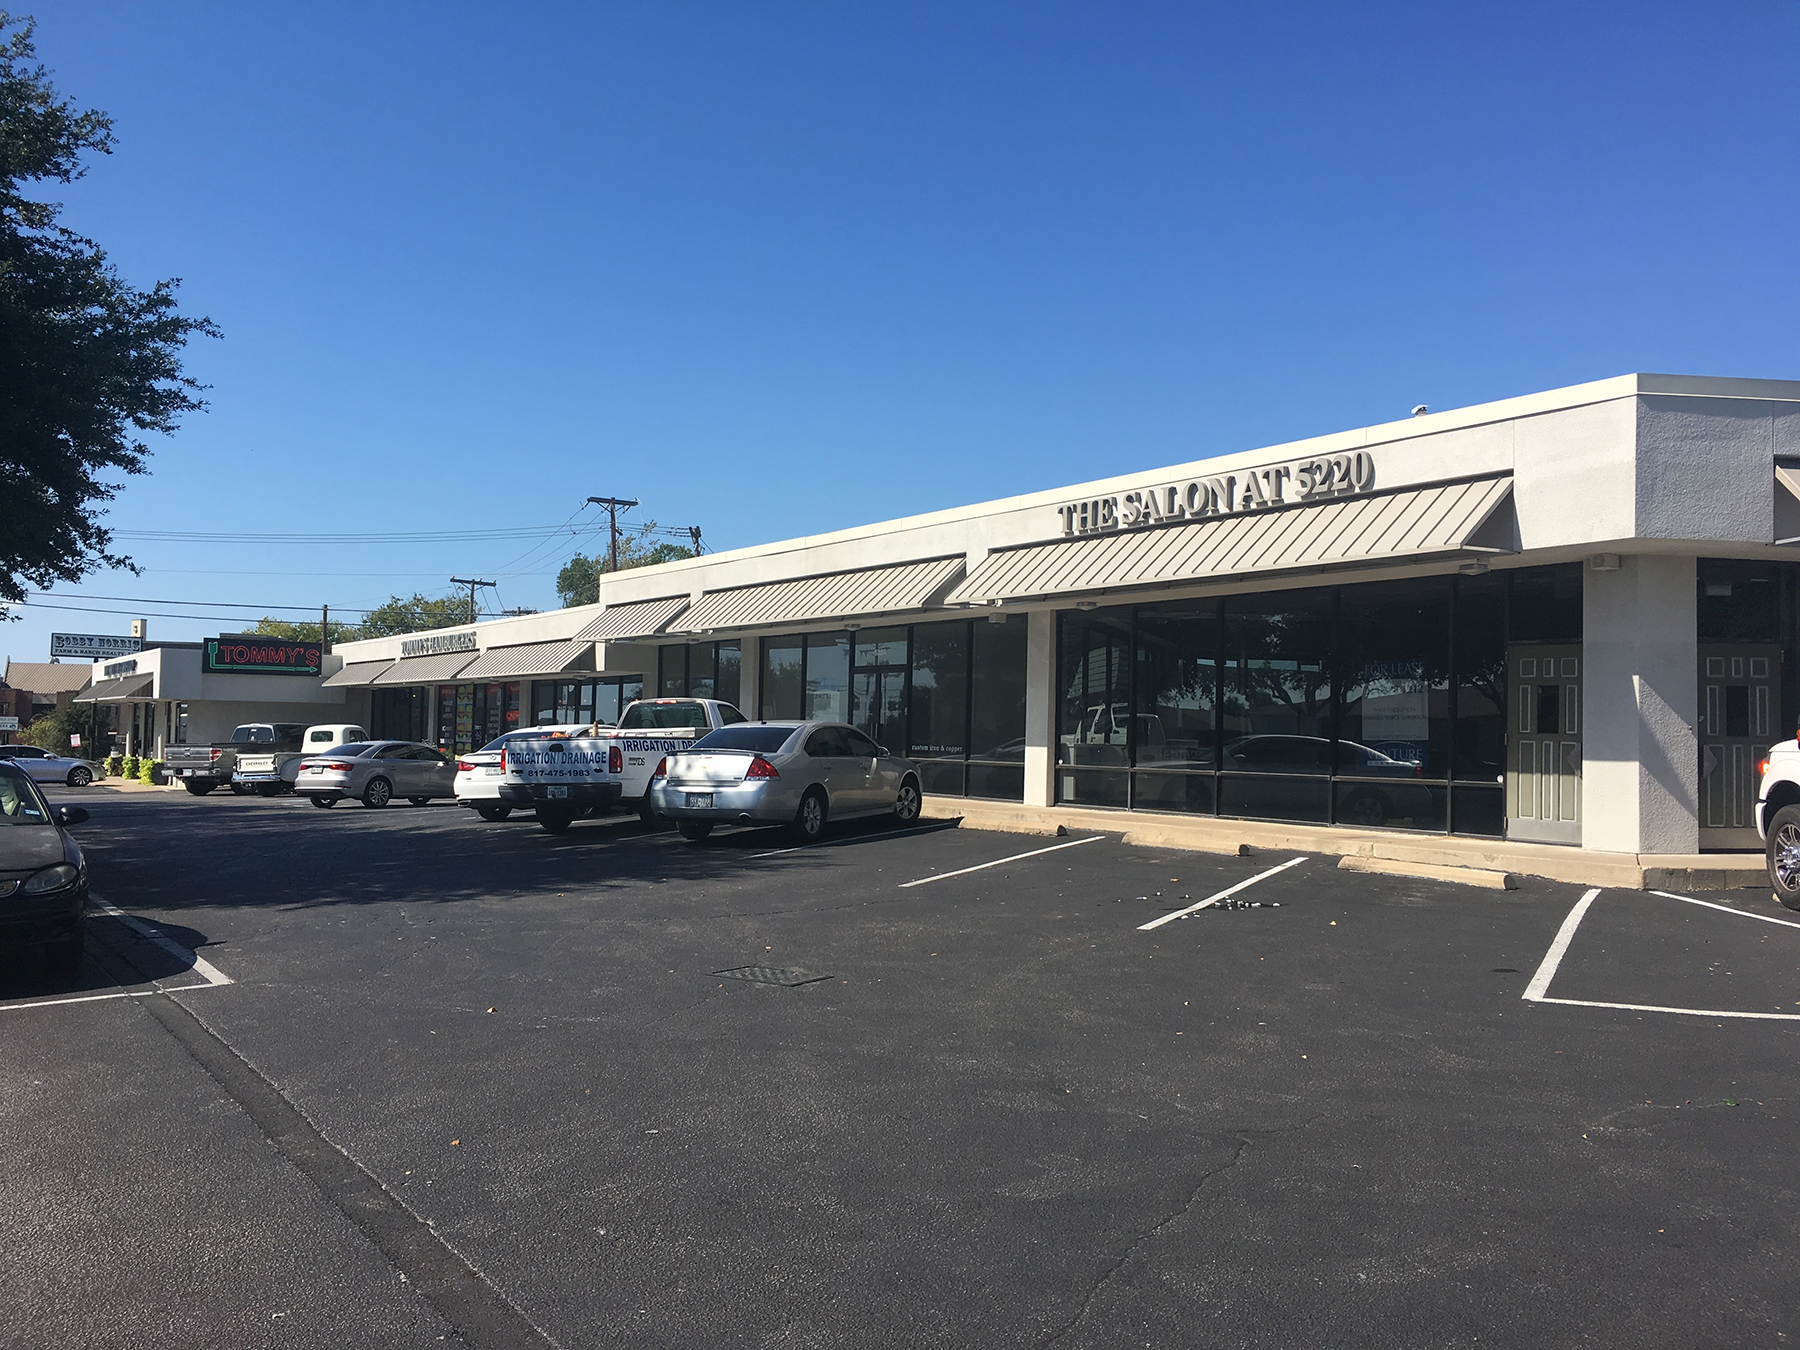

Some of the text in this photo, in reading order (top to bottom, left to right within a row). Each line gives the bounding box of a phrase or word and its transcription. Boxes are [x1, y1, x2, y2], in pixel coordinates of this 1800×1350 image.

[1057, 451, 1376, 537] THE SALON AT 5220
[54, 636, 140, 652] BOBBY NORRIS
[220, 645, 320, 667] TOMMY'S
[1364, 662, 1425, 676] FOR LEASE
[622, 740, 676, 752] IRRIGATION
[561, 751, 607, 764] DRAINAGE
[1366, 748, 1423, 760] VENTURE
[527, 769, 591, 777] 817-475-1983
